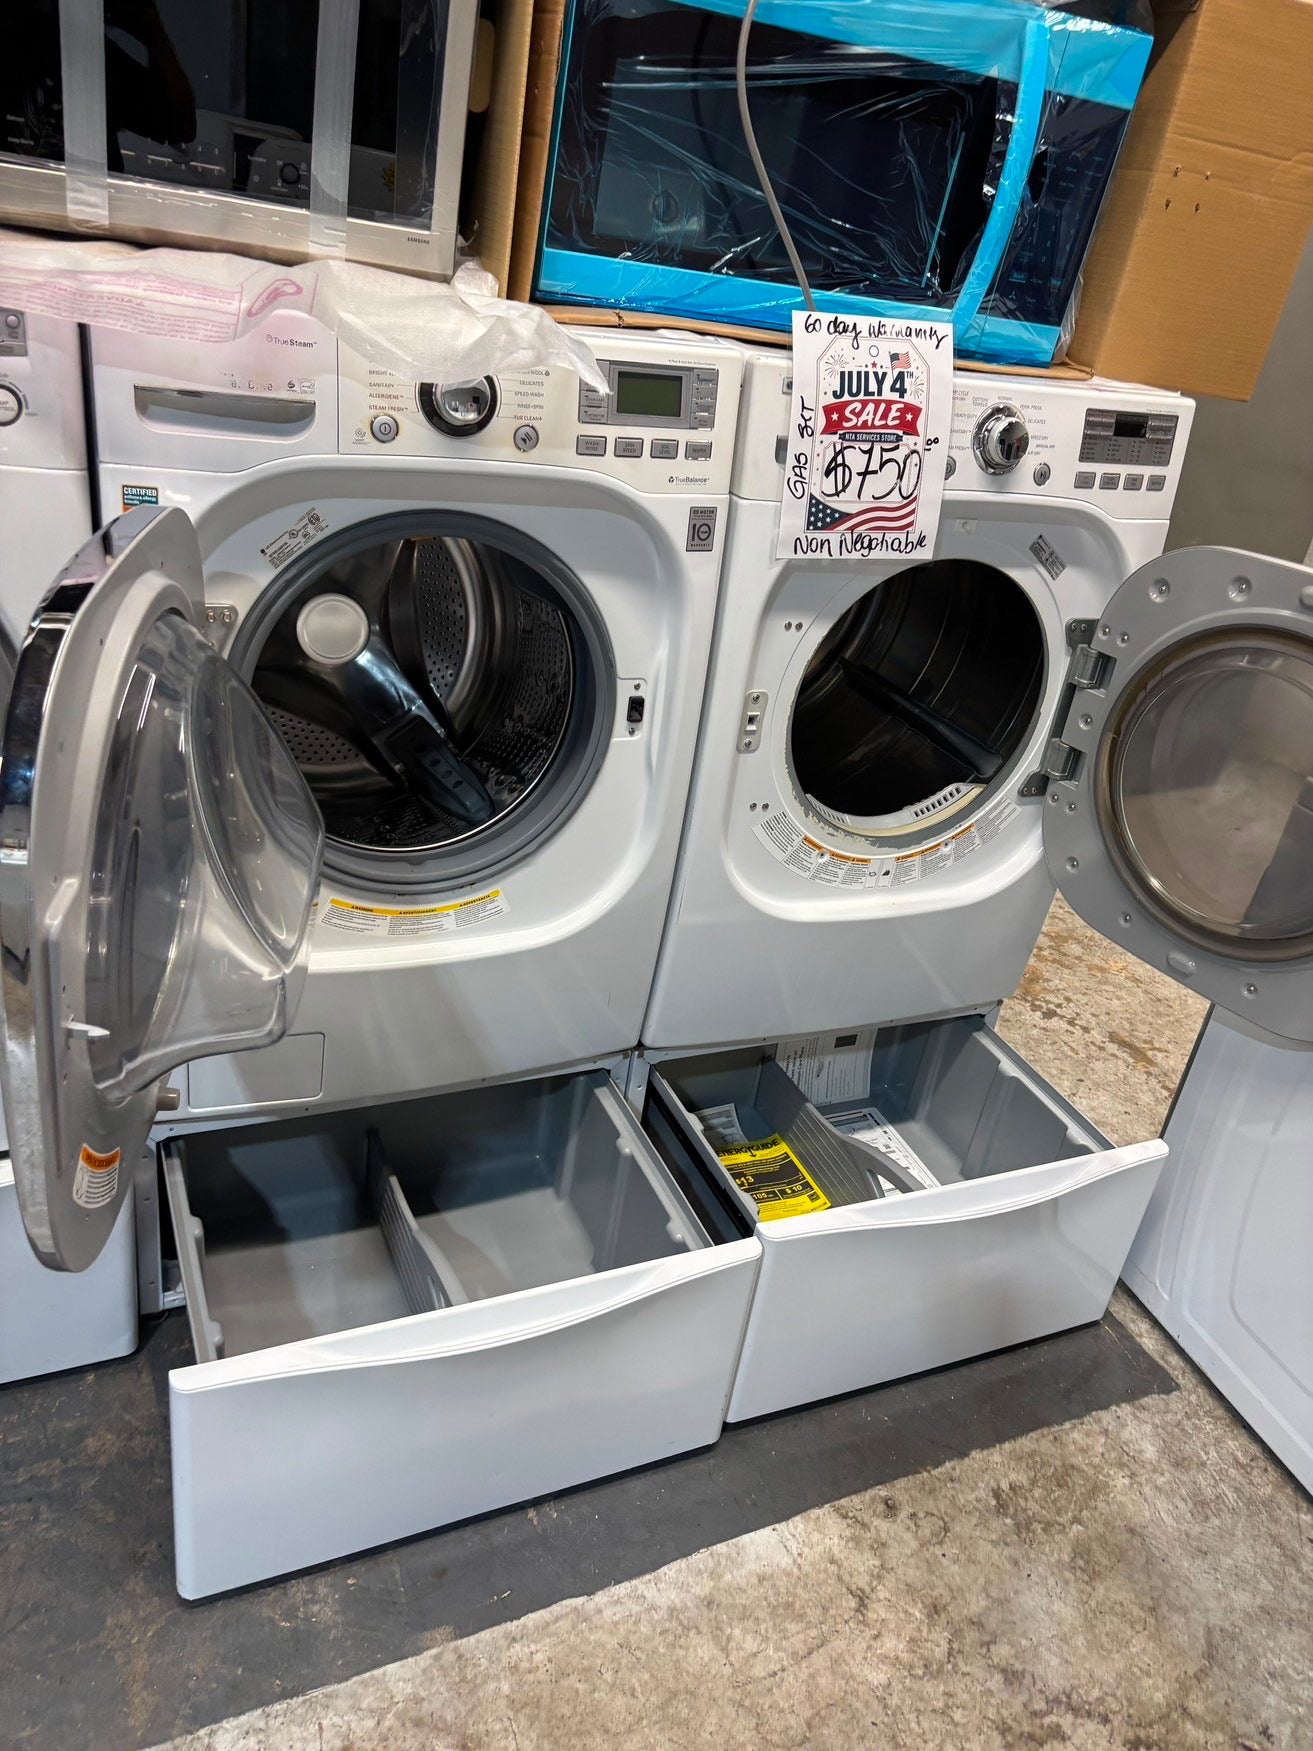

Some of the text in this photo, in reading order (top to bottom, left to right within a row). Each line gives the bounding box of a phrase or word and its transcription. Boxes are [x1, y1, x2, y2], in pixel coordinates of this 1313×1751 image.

[804, 313, 822, 333] 60
[827, 316, 862, 350] day
[832, 371, 887, 400] JULY
[842, 402, 901, 428] SALE
[787, 452, 808, 500] GAS
[821, 442, 923, 500] $750
[123, 486, 157, 496] CERTIFIED
[794, 530, 928, 558] Non Negotiable
